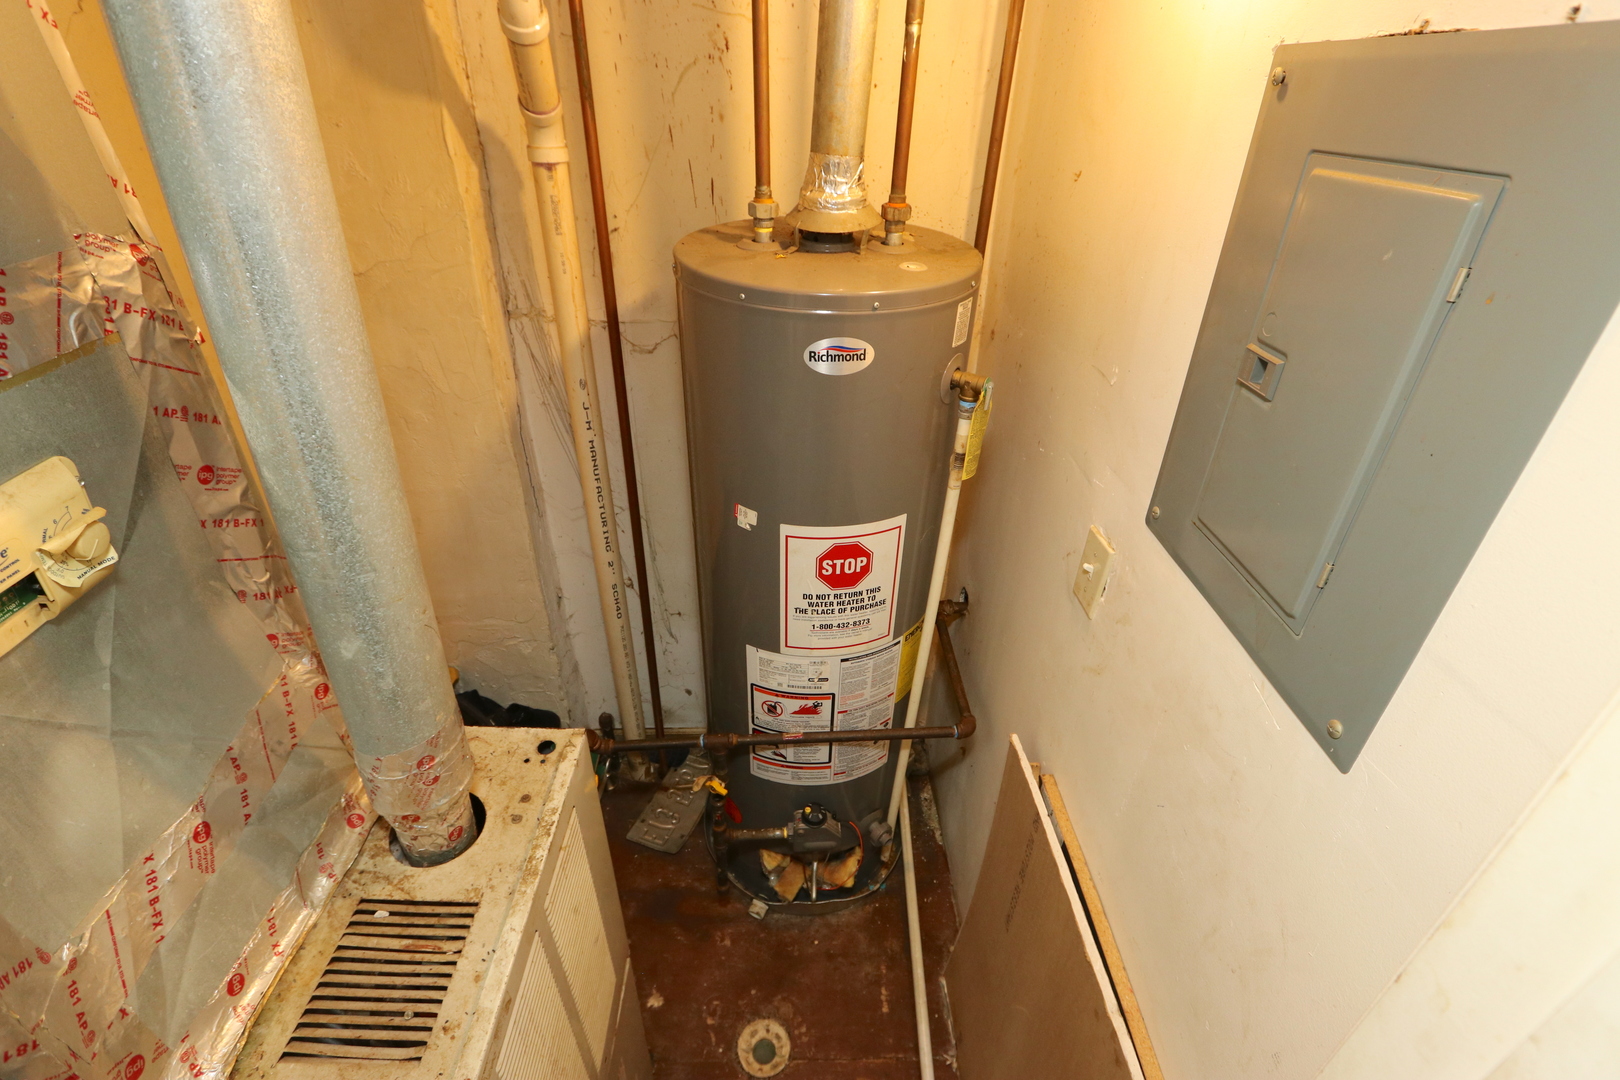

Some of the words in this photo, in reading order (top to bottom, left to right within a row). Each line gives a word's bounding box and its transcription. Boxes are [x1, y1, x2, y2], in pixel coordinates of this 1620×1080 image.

[123, 302, 157, 321] B-FX
[808, 348, 867, 362] Richmond
[193, 412, 208, 423] 181
[212, 520, 230, 528] 181
[233, 519, 257, 528] B-FX
[588, 439, 614, 553] MANUFACTURING
[611, 583, 623, 620] SCH40
[77, 565, 97, 580] MANUAL
[97, 556, 116, 566] MODE
[821, 557, 868, 575] STOP
[833, 590, 864, 600] RETURN
[866, 586, 881, 595] THIS
[836, 597, 865, 607] HEATER
[849, 598, 887, 612] PURCHASE
[811, 618, 871, 630] 1-800-432-8373
[282, 690, 294, 717] B-FX
[288, 721, 298, 740] 181
[240, 788, 250, 808] 181
[145, 869, 159, 893] 181
[149, 896, 164, 931] B-FX
[12, 957, 33, 978] 181
[67, 979, 82, 1007] 181
[2, 1039, 40, 1063] 181
[126, 1058, 144, 1076] ipg
